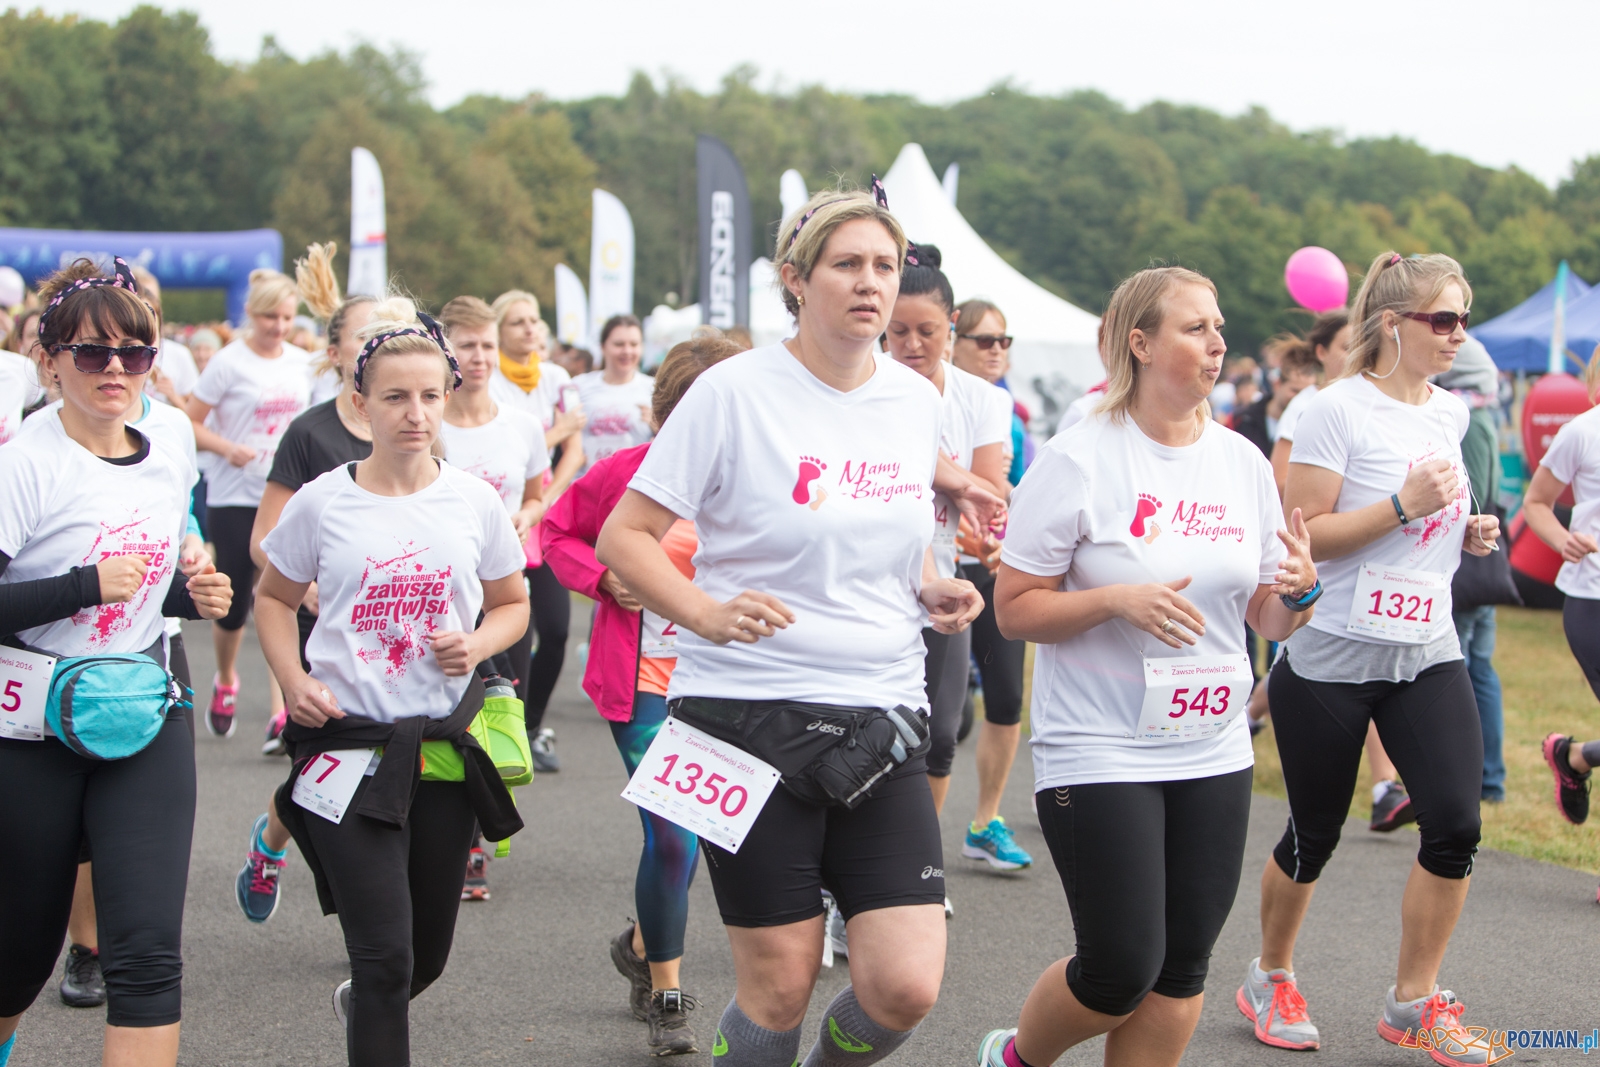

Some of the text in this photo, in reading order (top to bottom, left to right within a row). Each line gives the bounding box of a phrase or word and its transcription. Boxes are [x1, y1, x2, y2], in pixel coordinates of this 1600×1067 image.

[838, 459, 901, 486] Mamy
[1171, 499, 1227, 525] Mamy
[122, 543, 159, 552] BIEG KOBIET
[365, 581, 445, 600] zawsze
[391, 573, 437, 583] BIEG KOBIET
[1367, 589, 1434, 623] 1321
[355, 618, 388, 633] 2016
[15, 660, 33, 671] 2016
[1171, 668, 1195, 676] Zawsze
[0, 679, 23, 713] 5
[1168, 685, 1231, 719] 543
[684, 736, 710, 753] Zawsze
[736, 760, 756, 776] 2016
[653, 753, 749, 818] 1350
